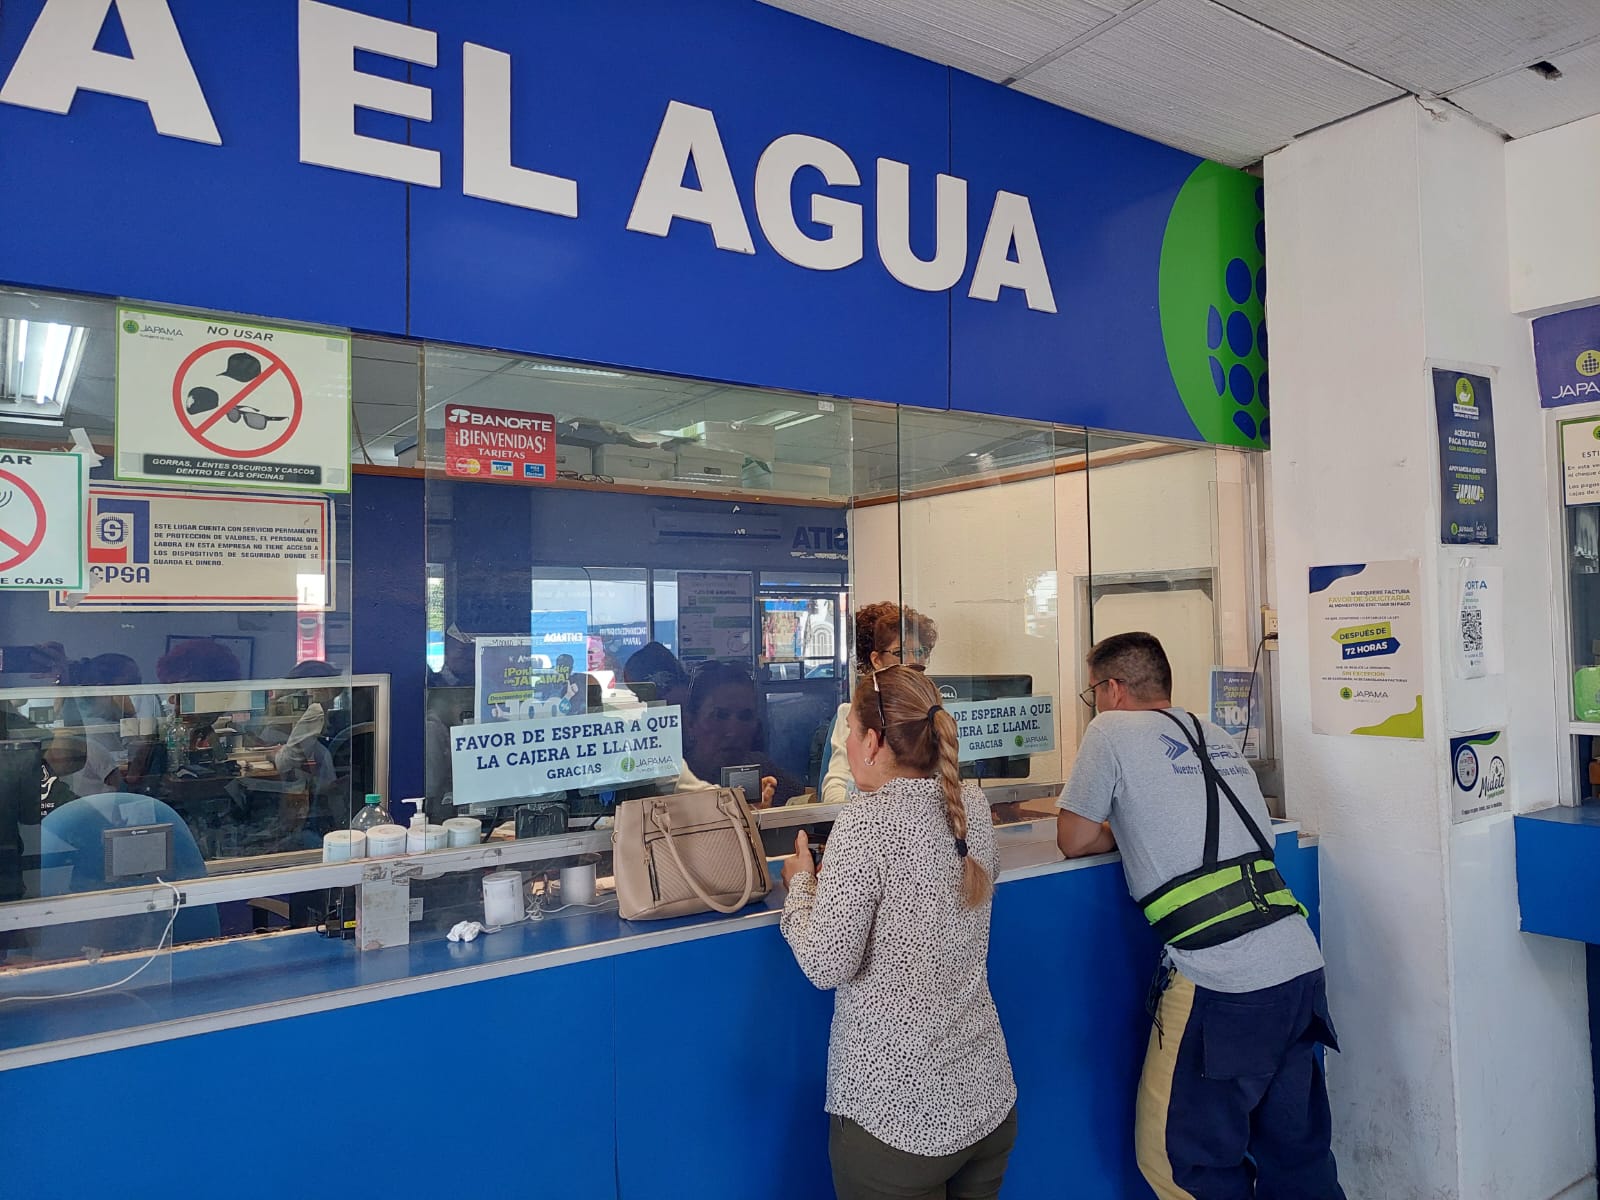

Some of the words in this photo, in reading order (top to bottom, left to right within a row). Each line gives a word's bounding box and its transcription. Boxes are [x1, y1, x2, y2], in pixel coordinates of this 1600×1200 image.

[0, 0, 222, 146] A
[298, 0, 578, 218] EL
[626, 99, 1057, 314] AGUA
[140, 324, 184, 337] JAPAMA
[207, 325, 229, 336] NO
[233, 327, 274, 341] USAR
[470, 413, 553, 433] BANORTE
[455, 428, 546, 454] ¡BIENVENIDAS!
[478, 447, 526, 460] TARJETAS
[175, 467, 212, 476] DENTRO
[213, 469, 227, 477] DE
[246, 472, 285, 481] OFICINAS
[196, 461, 231, 470] LENTES
[232, 463, 273, 472] OSCUROS
[281, 467, 315, 475] CASCOS
[14, 577, 64, 585] CAJAS
[1339, 629, 1375, 640] DESPUÉS
[1376, 627, 1386, 635] DE
[1344, 647, 1356, 656] 72
[1356, 641, 1388, 654] HORAS
[971, 706, 1017, 721] ESPERAR
[1020, 705, 1027, 716] A
[1030, 703, 1052, 717] QUE
[455, 732, 516, 752] FAVOR
[522, 729, 545, 744] DE
[551, 720, 625, 742] ESPERAR
[629, 719, 642, 732] A
[646, 714, 679, 731] QUE
[987, 723, 999, 735] LE
[1003, 719, 1040, 733] LLAME.
[476, 754, 500, 770] LA
[506, 747, 571, 767] CAJERA
[576, 743, 597, 758] LE
[602, 735, 663, 755] LLAME.
[969, 739, 1003, 751] GRACIAS
[635, 755, 674, 769] JAPAMA
[546, 763, 602, 780] GRACIAS
